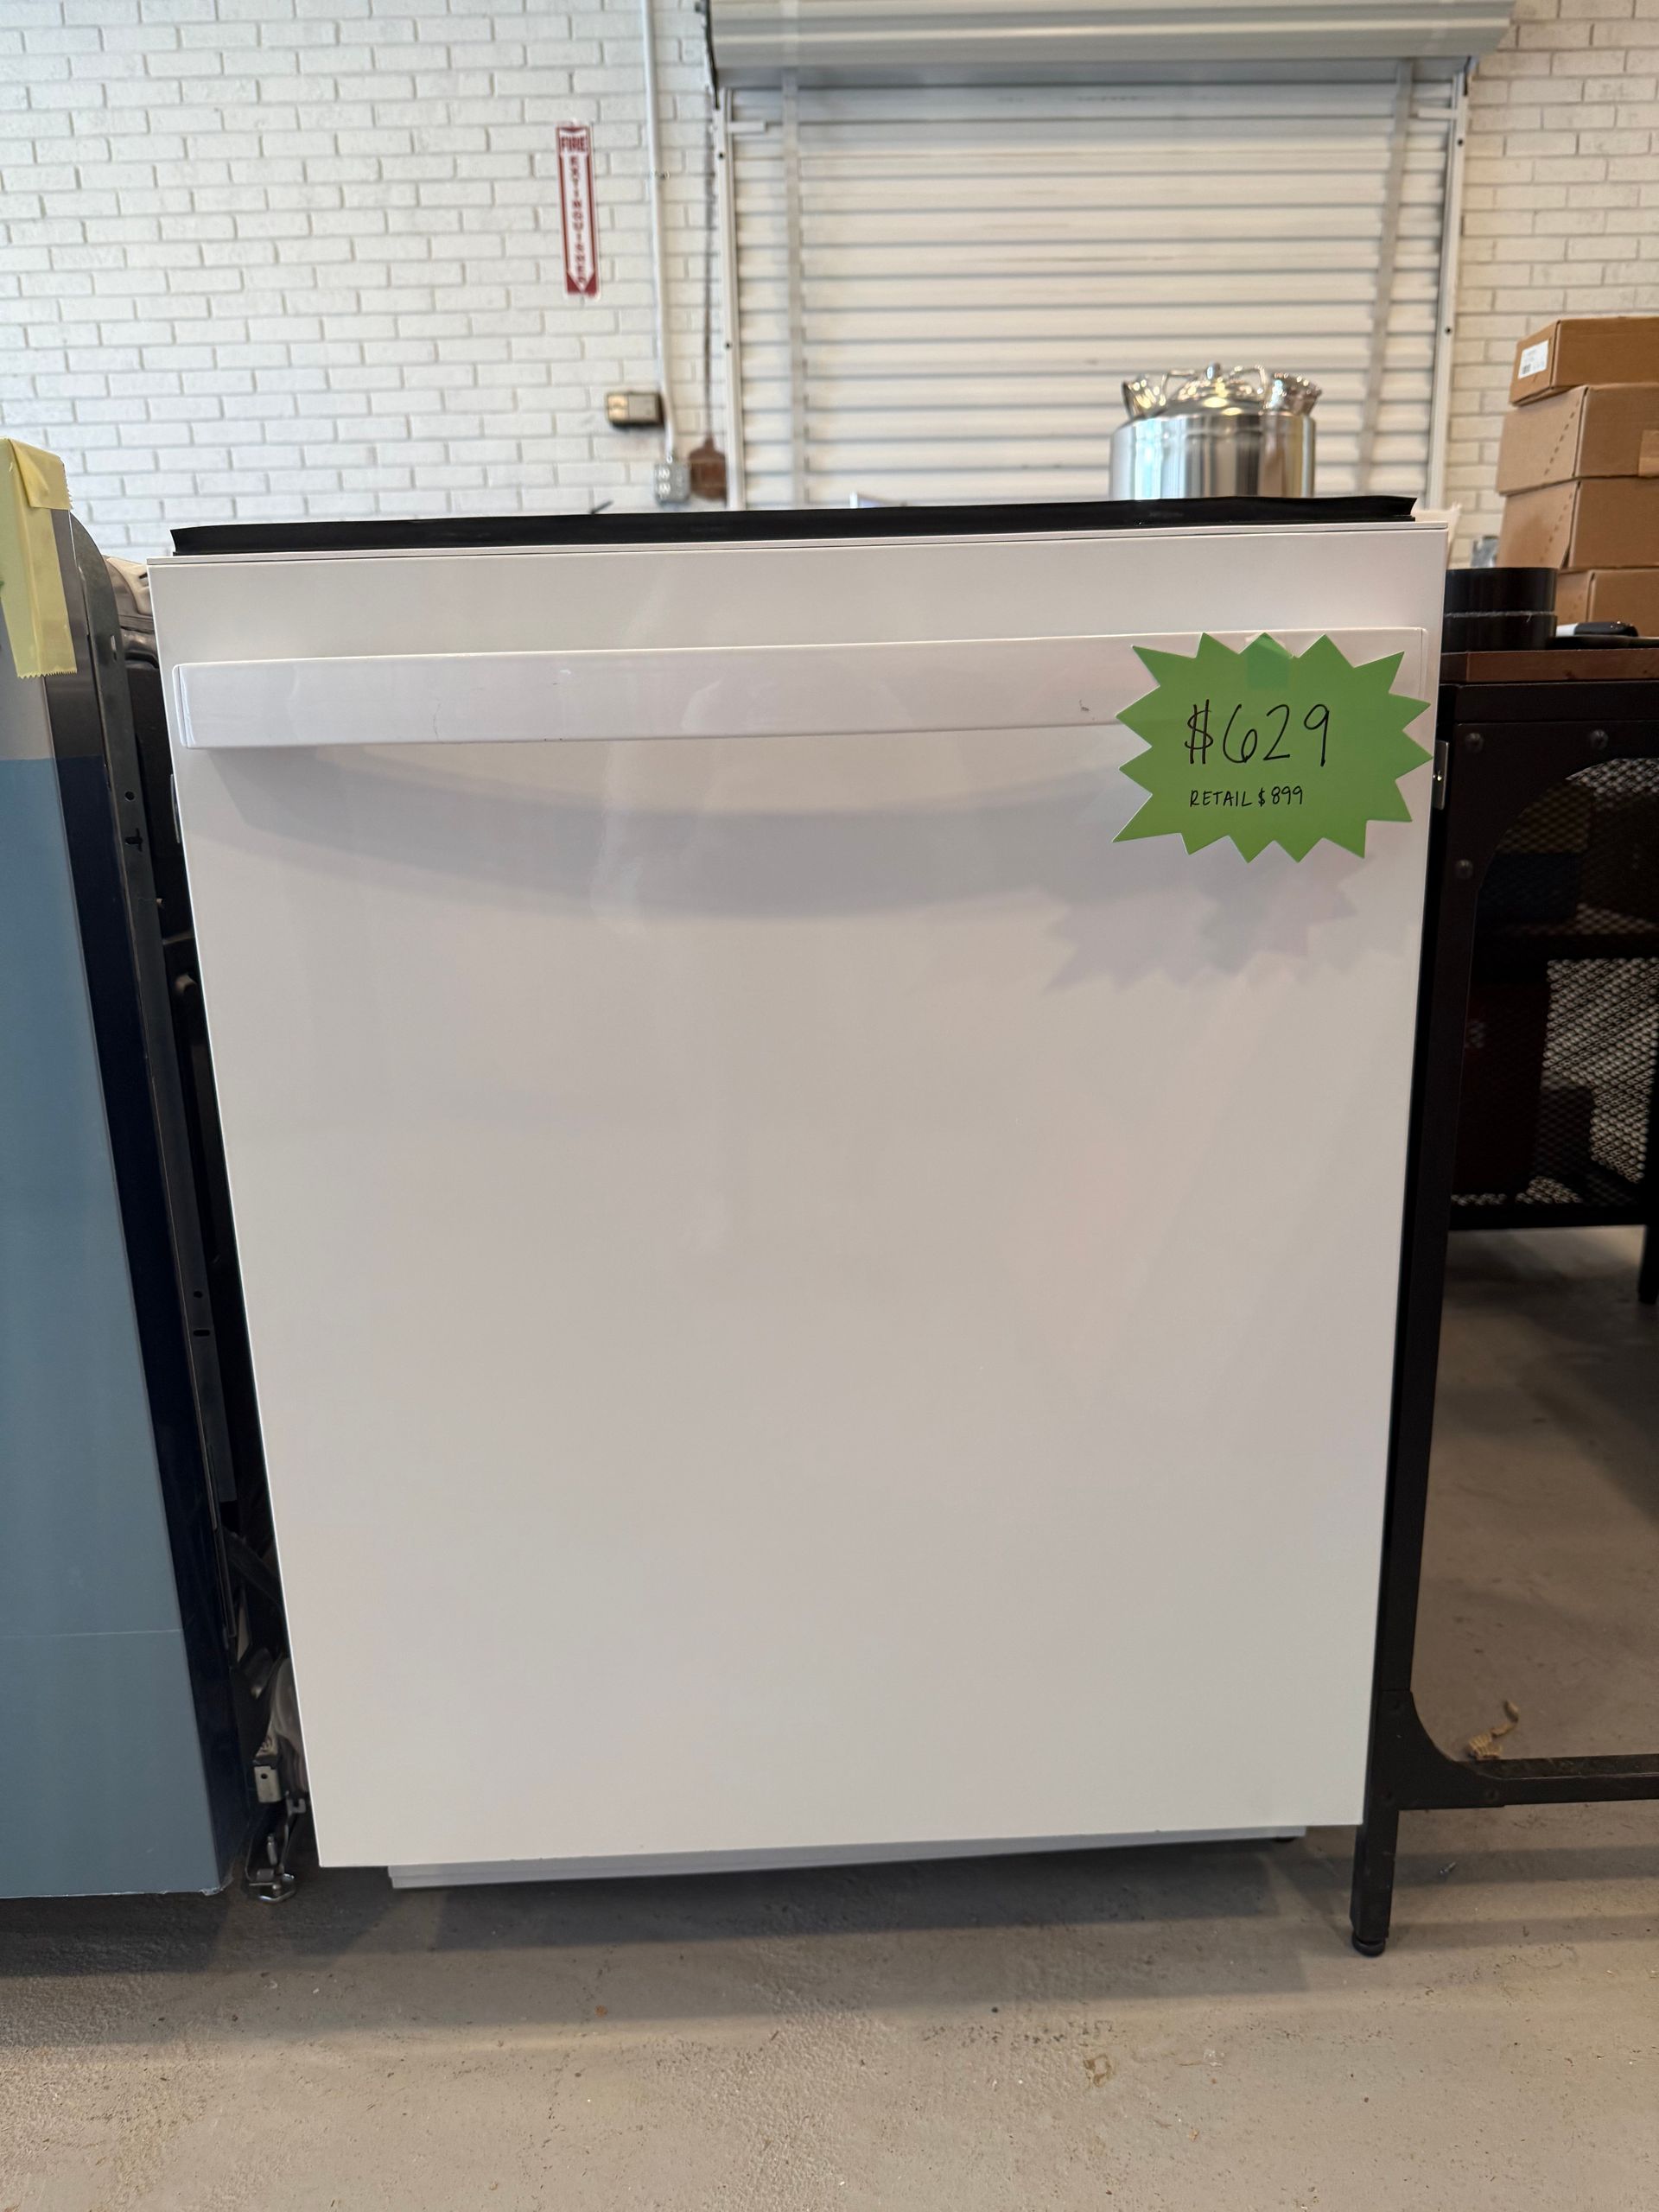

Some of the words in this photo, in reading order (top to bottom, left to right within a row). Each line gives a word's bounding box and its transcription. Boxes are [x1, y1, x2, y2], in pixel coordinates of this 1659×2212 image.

[561, 136, 588, 153] FIRE
[1184, 699, 1331, 767] $629
[1190, 790, 1252, 808] RETAIL
[1257, 785, 1303, 807] $899
